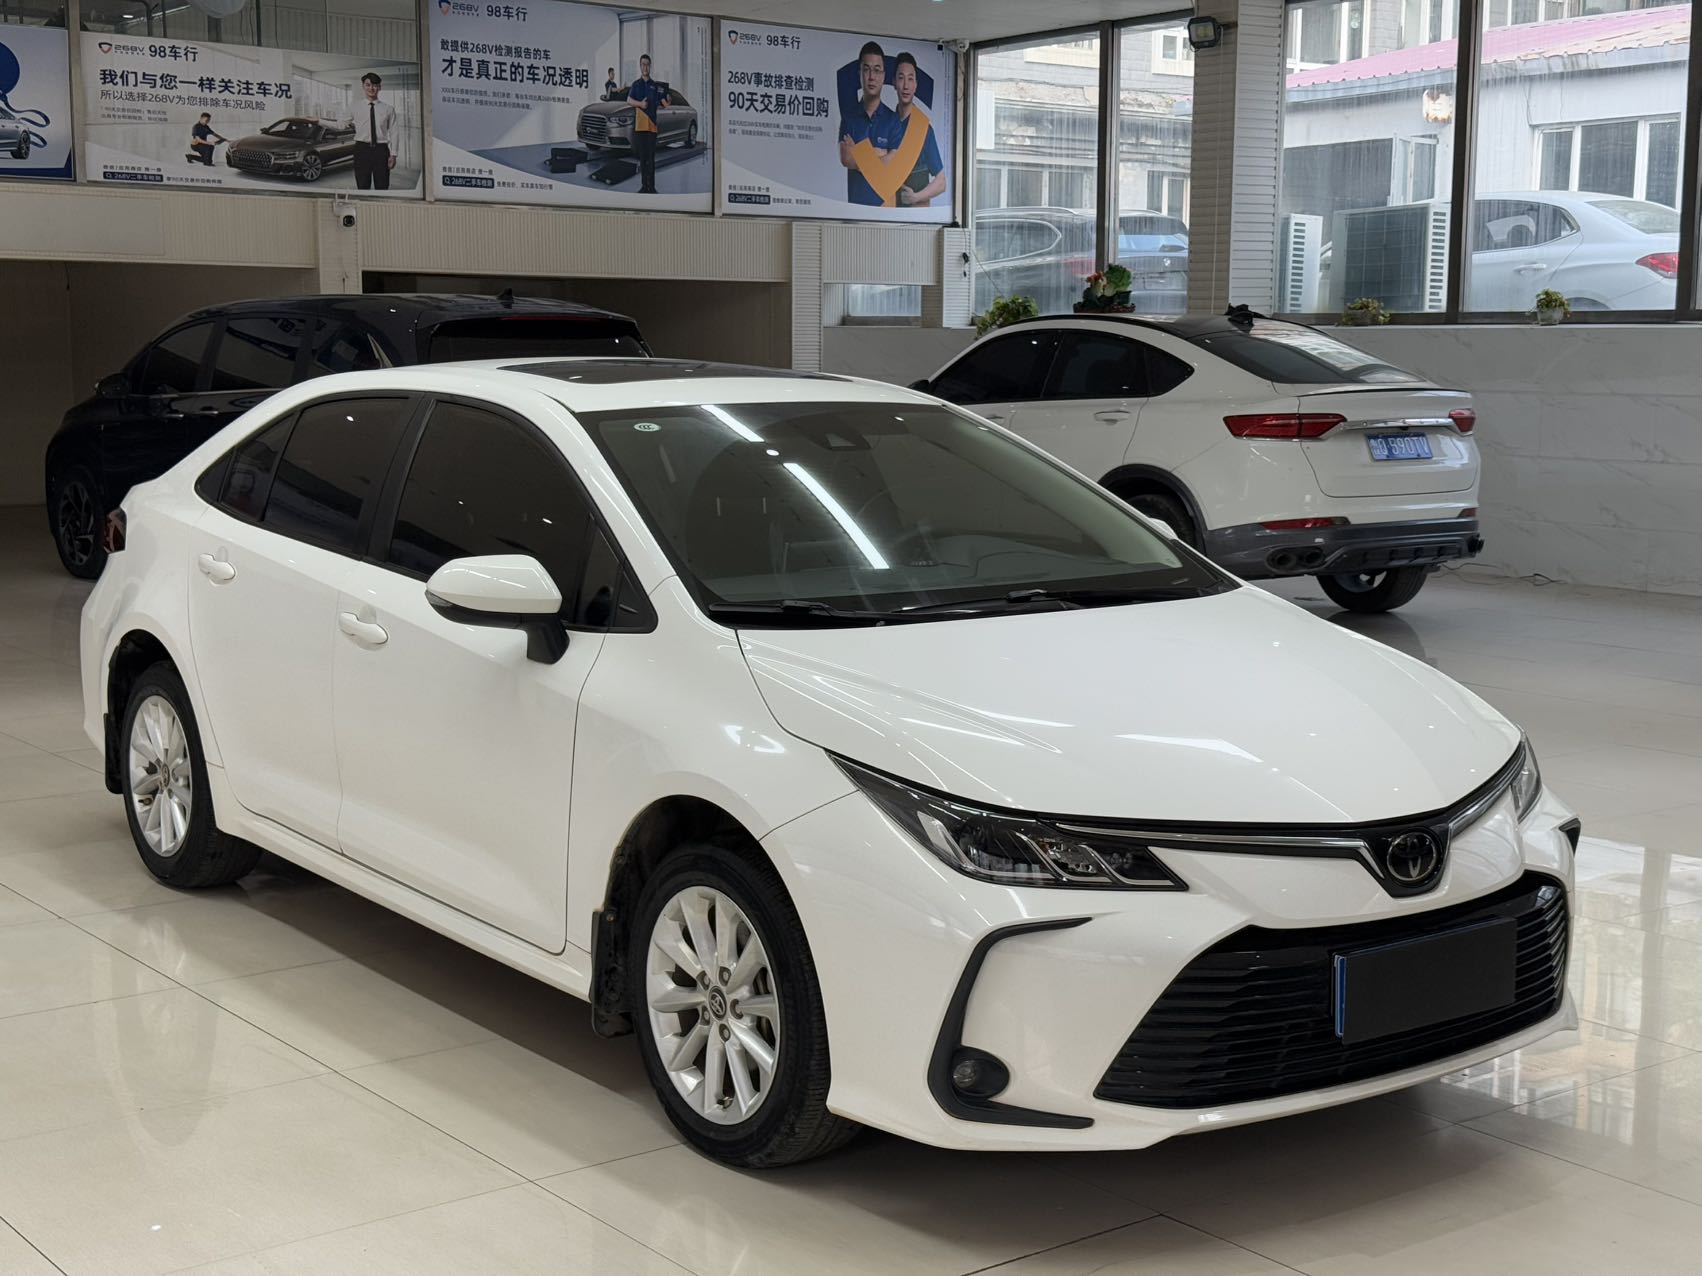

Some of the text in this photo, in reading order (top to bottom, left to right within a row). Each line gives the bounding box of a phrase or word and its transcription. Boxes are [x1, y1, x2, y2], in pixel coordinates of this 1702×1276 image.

[486, 5, 528, 22] 98车行
[148, 44, 198, 62] 98车行
[440, 38, 551, 61] 敢提供268V检测报告的车
[766, 34, 801, 50] 98车行
[99, 68, 292, 99] 我们与您一样关注车况
[441, 56, 589, 89] 才是真正的车况透明
[728, 70, 814, 92] 268V事故排查检测
[100, 89, 266, 111] 所以选择268V为您排除车况风险
[728, 91, 829, 118] 90天交易价回购
